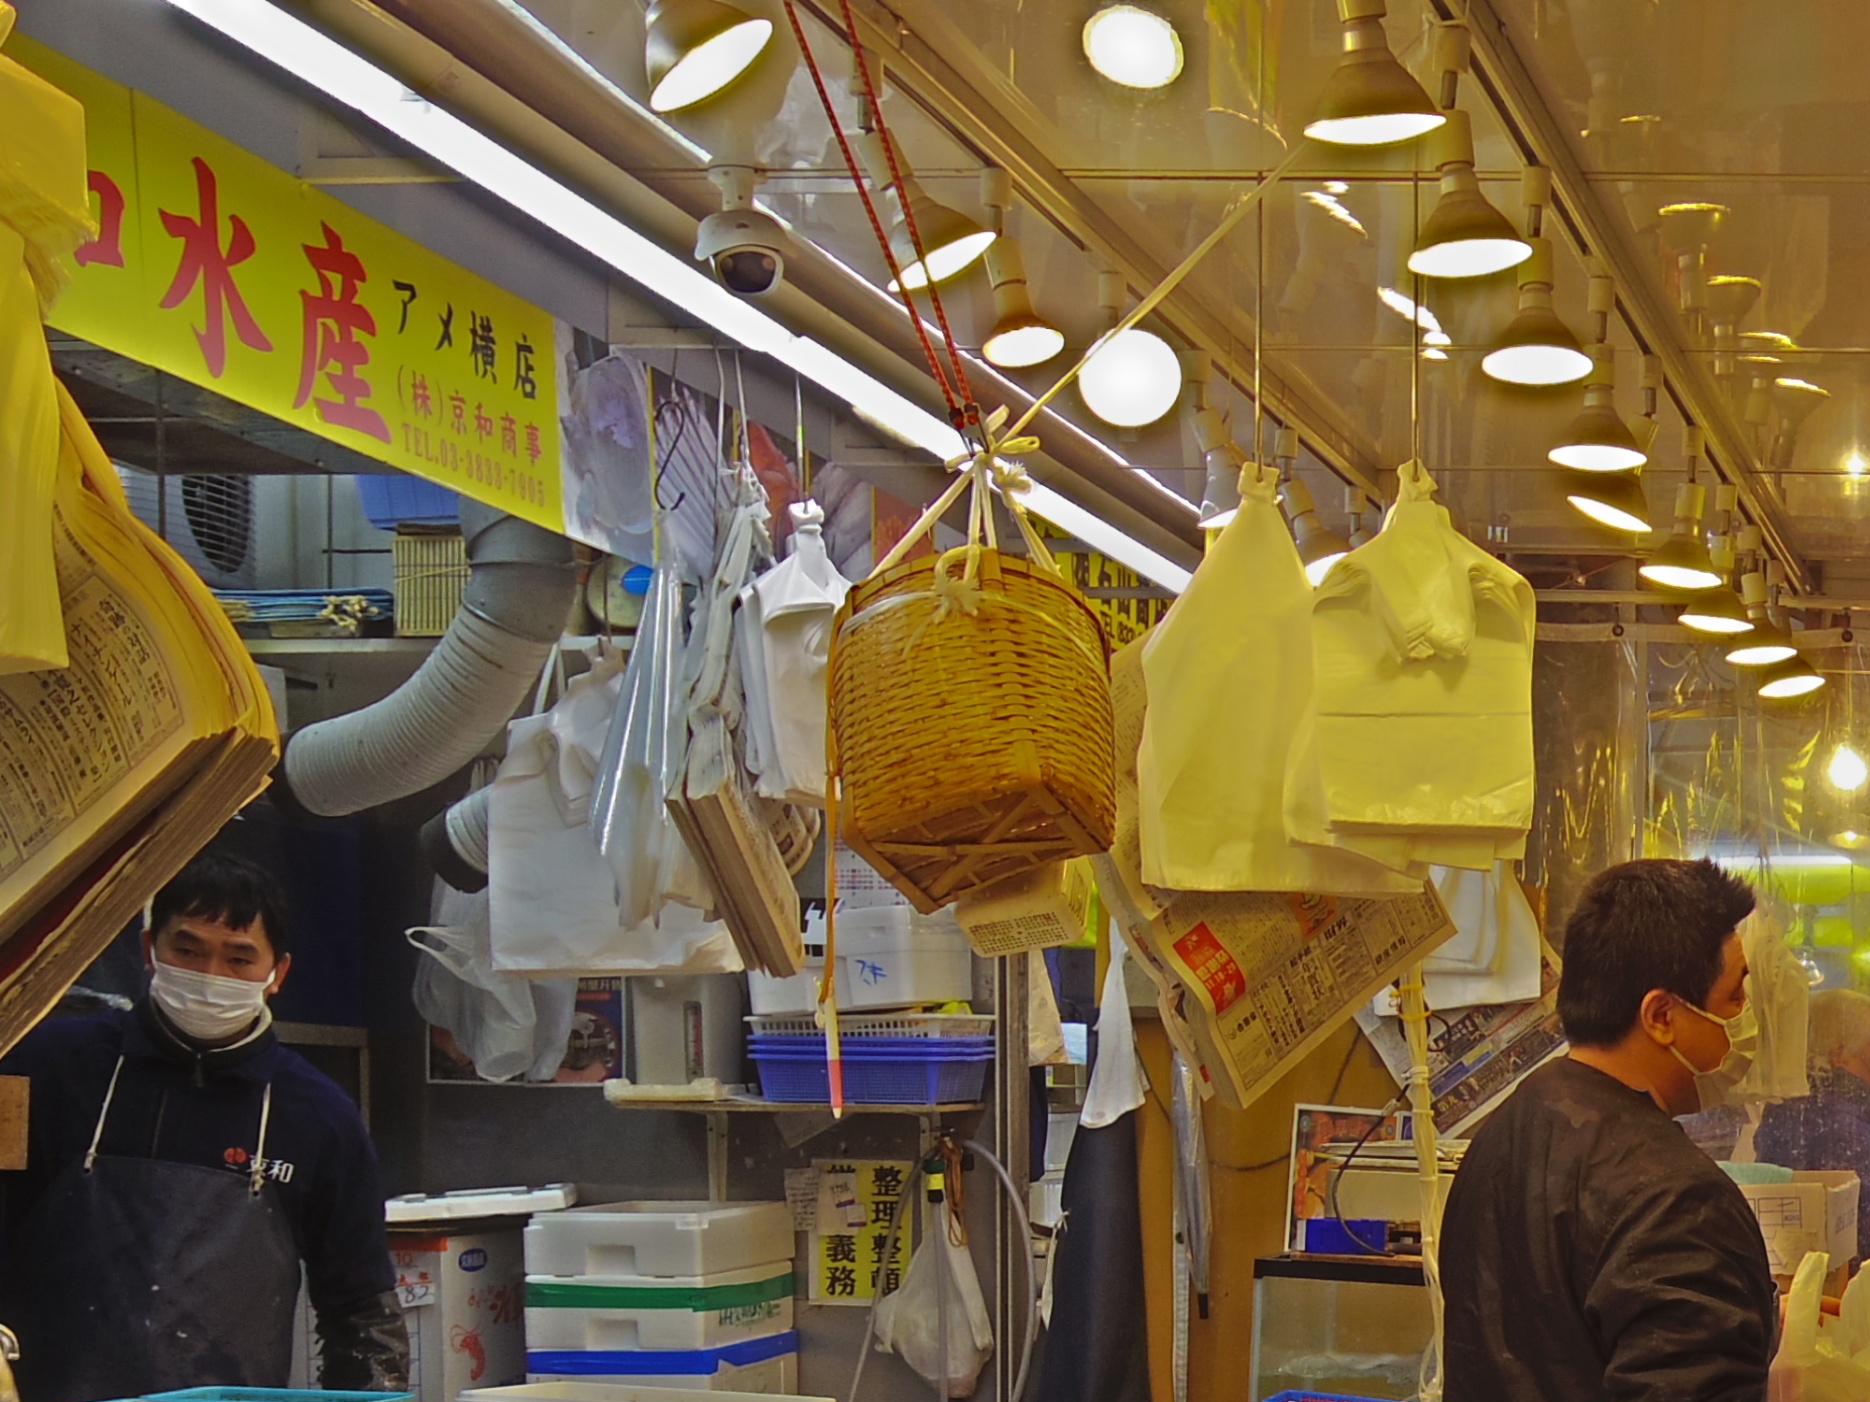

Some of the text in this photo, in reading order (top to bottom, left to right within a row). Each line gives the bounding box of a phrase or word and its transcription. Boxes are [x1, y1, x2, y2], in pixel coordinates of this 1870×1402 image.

[392, 279, 537, 400] アメ横店
[397, 365, 542, 467] (株)京和商事
